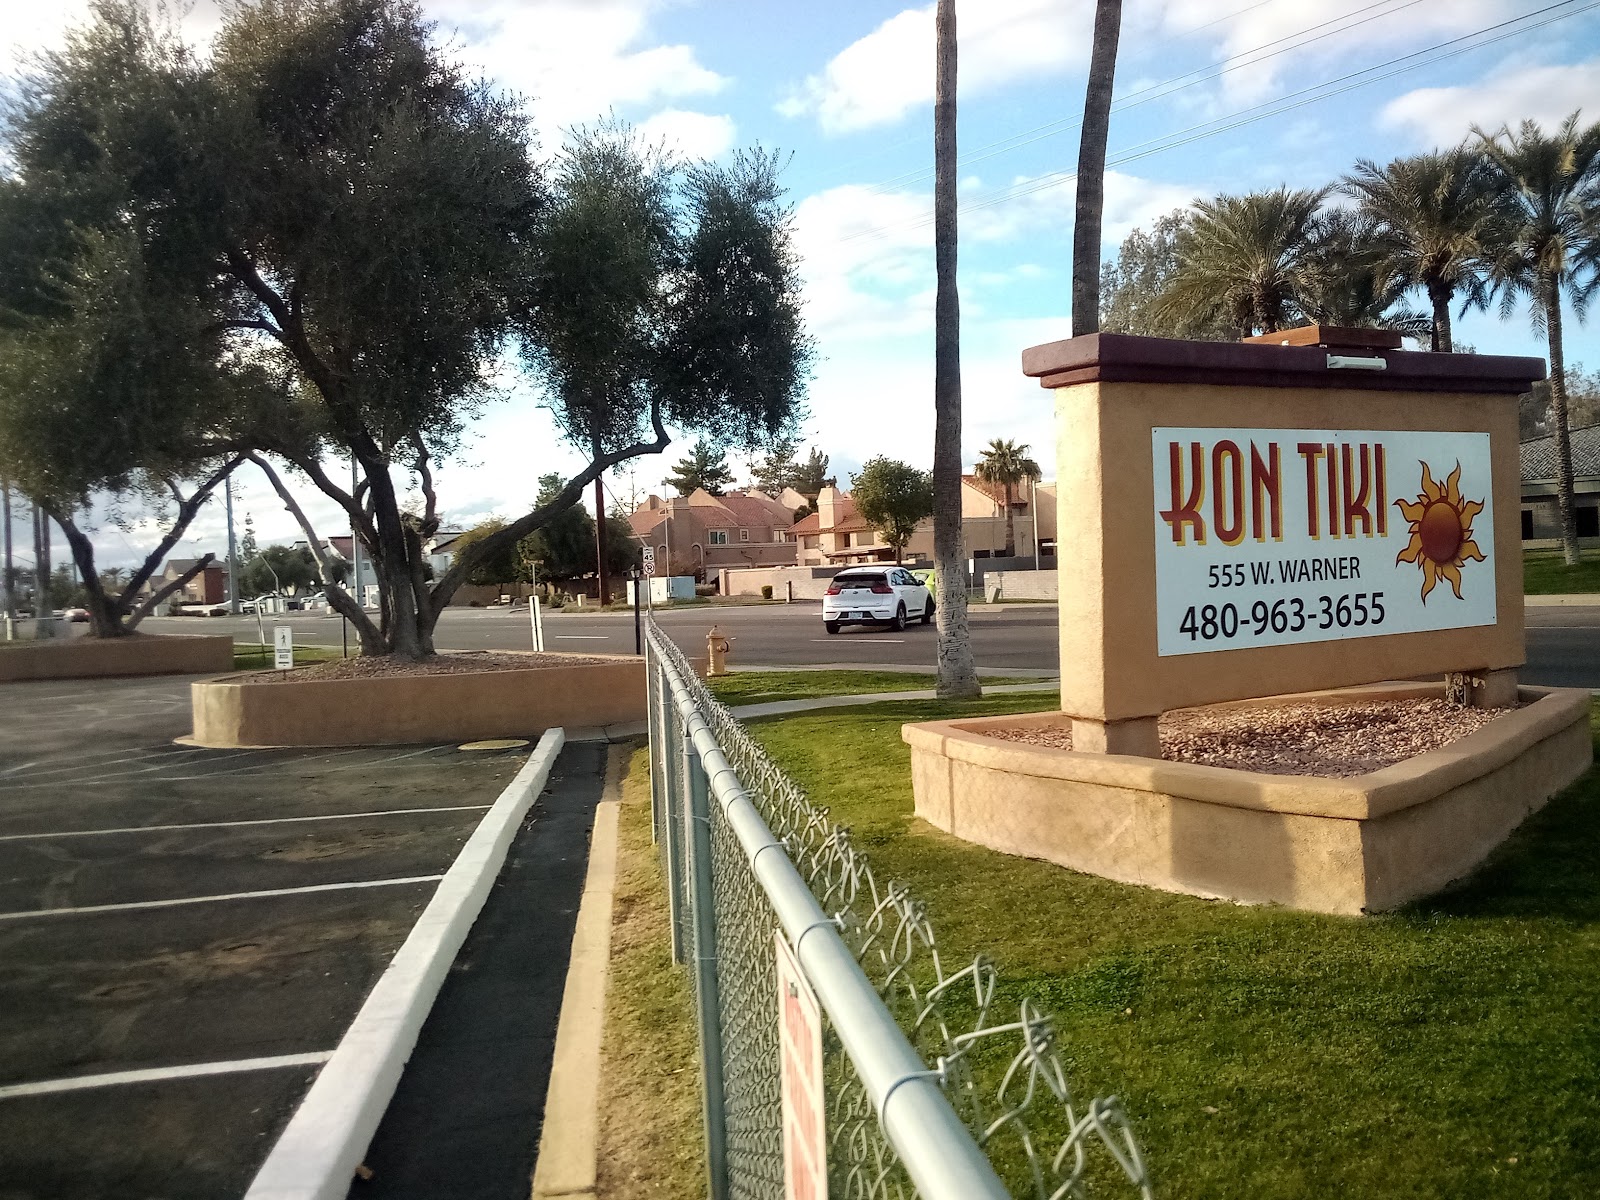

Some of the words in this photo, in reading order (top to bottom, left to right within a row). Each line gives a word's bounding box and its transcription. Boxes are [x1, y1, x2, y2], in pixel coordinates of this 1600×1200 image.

[1159, 439, 1283, 546] KON
[1297, 442, 1388, 541] TIKI
[1208, 563, 1246, 588] 555
[1251, 561, 1275, 585] W.
[1279, 556, 1361, 582] WARNER
[1179, 591, 1385, 641] 480-963-3655
